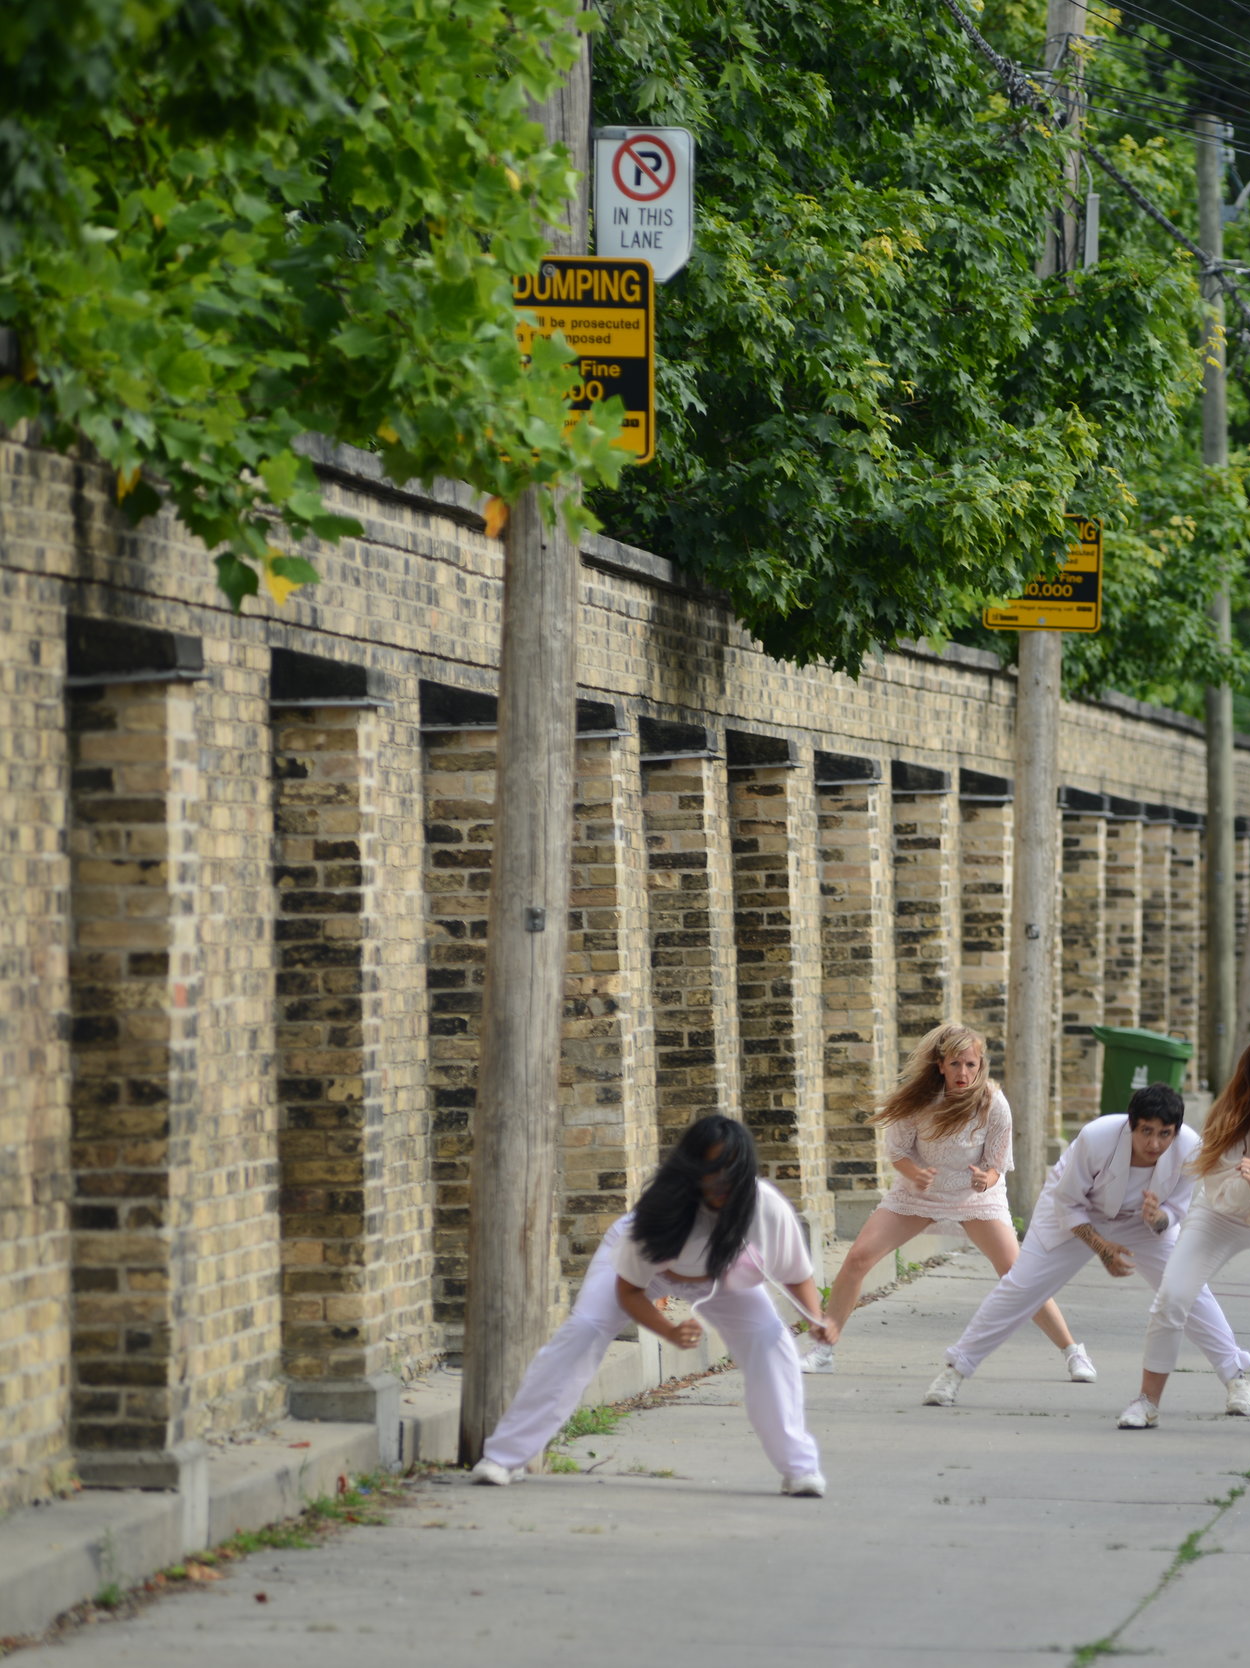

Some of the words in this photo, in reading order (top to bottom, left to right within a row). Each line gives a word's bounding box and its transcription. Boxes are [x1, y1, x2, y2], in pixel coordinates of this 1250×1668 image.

[613, 207, 629, 225] IN
[638, 207, 673, 227] THIS
[620, 231, 663, 249] LANE
[513, 268, 641, 303] DUMPING
[550, 317, 565, 328] be
[571, 318, 640, 330] prosecuted
[517, 332, 524, 342] a
[563, 333, 611, 345] mposed
[580, 360, 621, 377] Fine
[1025, 583, 1073, 597] 10,000
